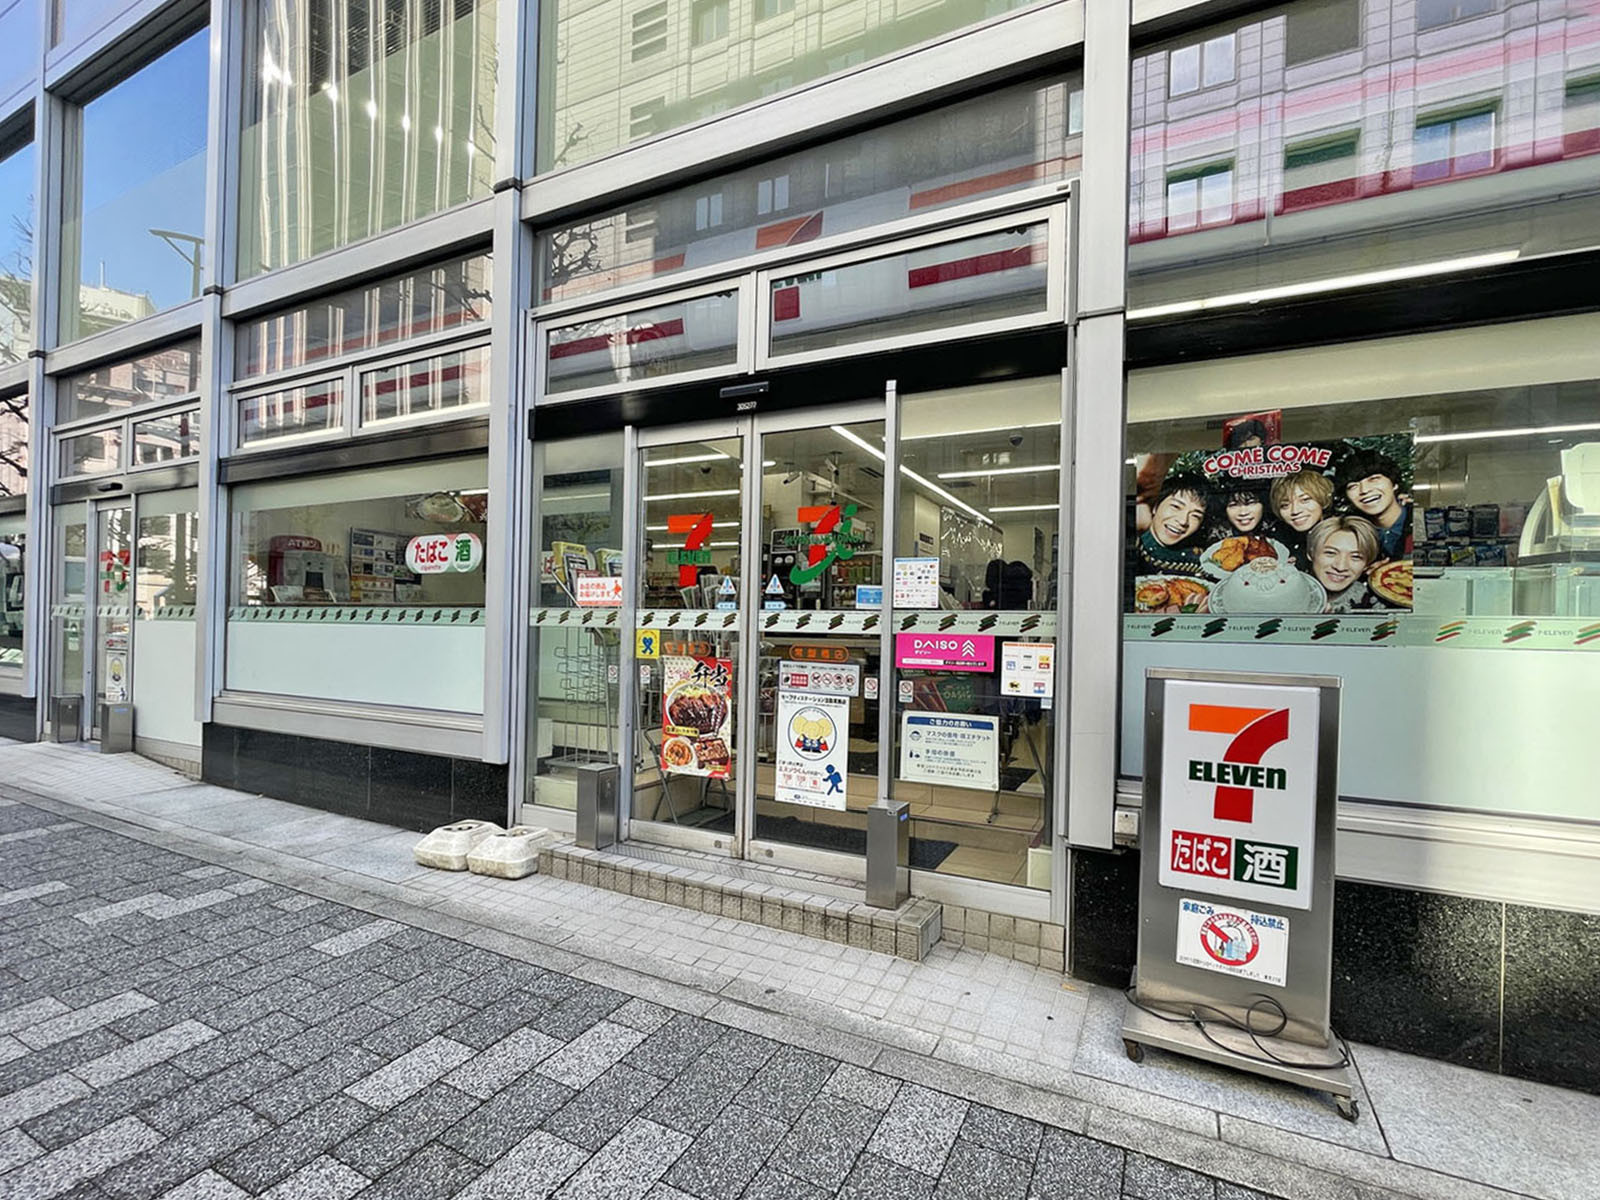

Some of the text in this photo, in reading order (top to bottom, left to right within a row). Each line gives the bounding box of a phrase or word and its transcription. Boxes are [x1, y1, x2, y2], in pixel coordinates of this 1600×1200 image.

[1204, 446, 1331, 473] COME COME
[1230, 463, 1300, 477] CHRISTMAS
[415, 541, 448, 563] たばこ
[456, 539, 471, 562] 酒
[914, 639, 958, 650] DAISO
[691, 661, 728, 688] 弁当
[1189, 704, 1289, 823] 7
[1173, 834, 1289, 886] たばこ 酒
[1183, 901, 1214, 916] 家庭ごみ
[1250, 914, 1285, 931] 持込禁止
